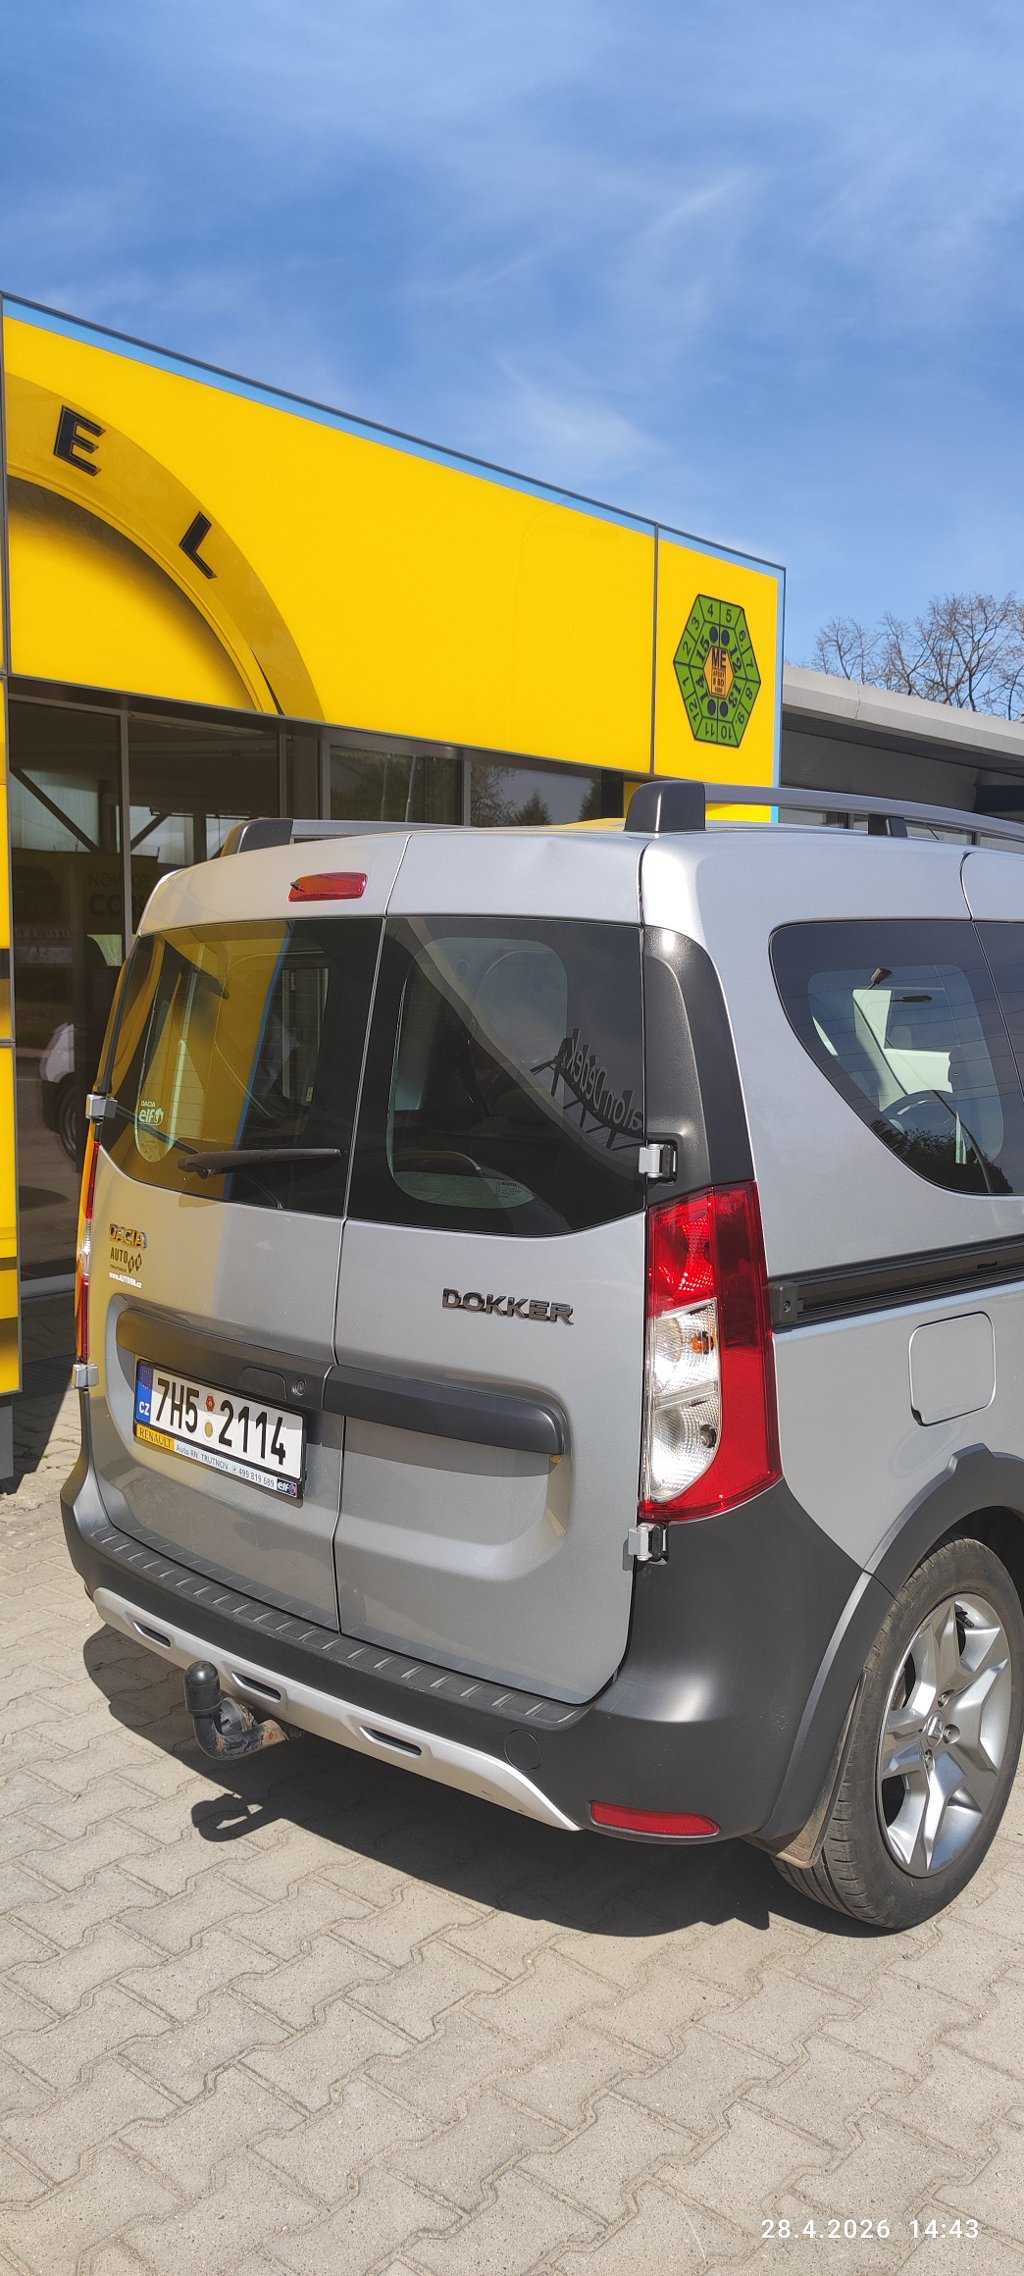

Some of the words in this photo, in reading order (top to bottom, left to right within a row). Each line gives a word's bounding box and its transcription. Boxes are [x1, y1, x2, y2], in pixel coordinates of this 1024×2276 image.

[706, 603, 714, 617] 4
[725, 608, 732, 622] 5
[691, 616, 700, 630] 3
[683, 640, 692, 656] 2
[696, 634, 710, 664] 15
[712, 648, 727, 668] ME
[729, 644, 742, 673] 12
[746, 658, 754, 668] 7
[682, 676, 690, 687] 1
[695, 674, 709, 703] 14
[729, 682, 742, 708] 13
[746, 687, 753, 700] 8
[688, 698, 700, 722] 12
[705, 721, 715, 737] 11
[720, 725, 733, 740] 10
[138, 1108, 155, 1123] elf
[109, 1223, 147, 1249] DACIA
[110, 1247, 129, 1264] AUTO
[441, 1287, 575, 1326] DOKKER
[138, 1400, 150, 1417] CZ
[155, 1377, 200, 1434] 7H5
[218, 1399, 287, 1466] 2114
[139, 1427, 172, 1449] RENAULT
[176, 1444, 190, 1456] Auto
[201, 1453, 229, 1471] TRUTNOV
[239, 1467, 250, 1478] 499
[250, 1472, 262, 1483] 819
[263, 1476, 275, 1488] 689
[277, 1480, 289, 1491] elf
